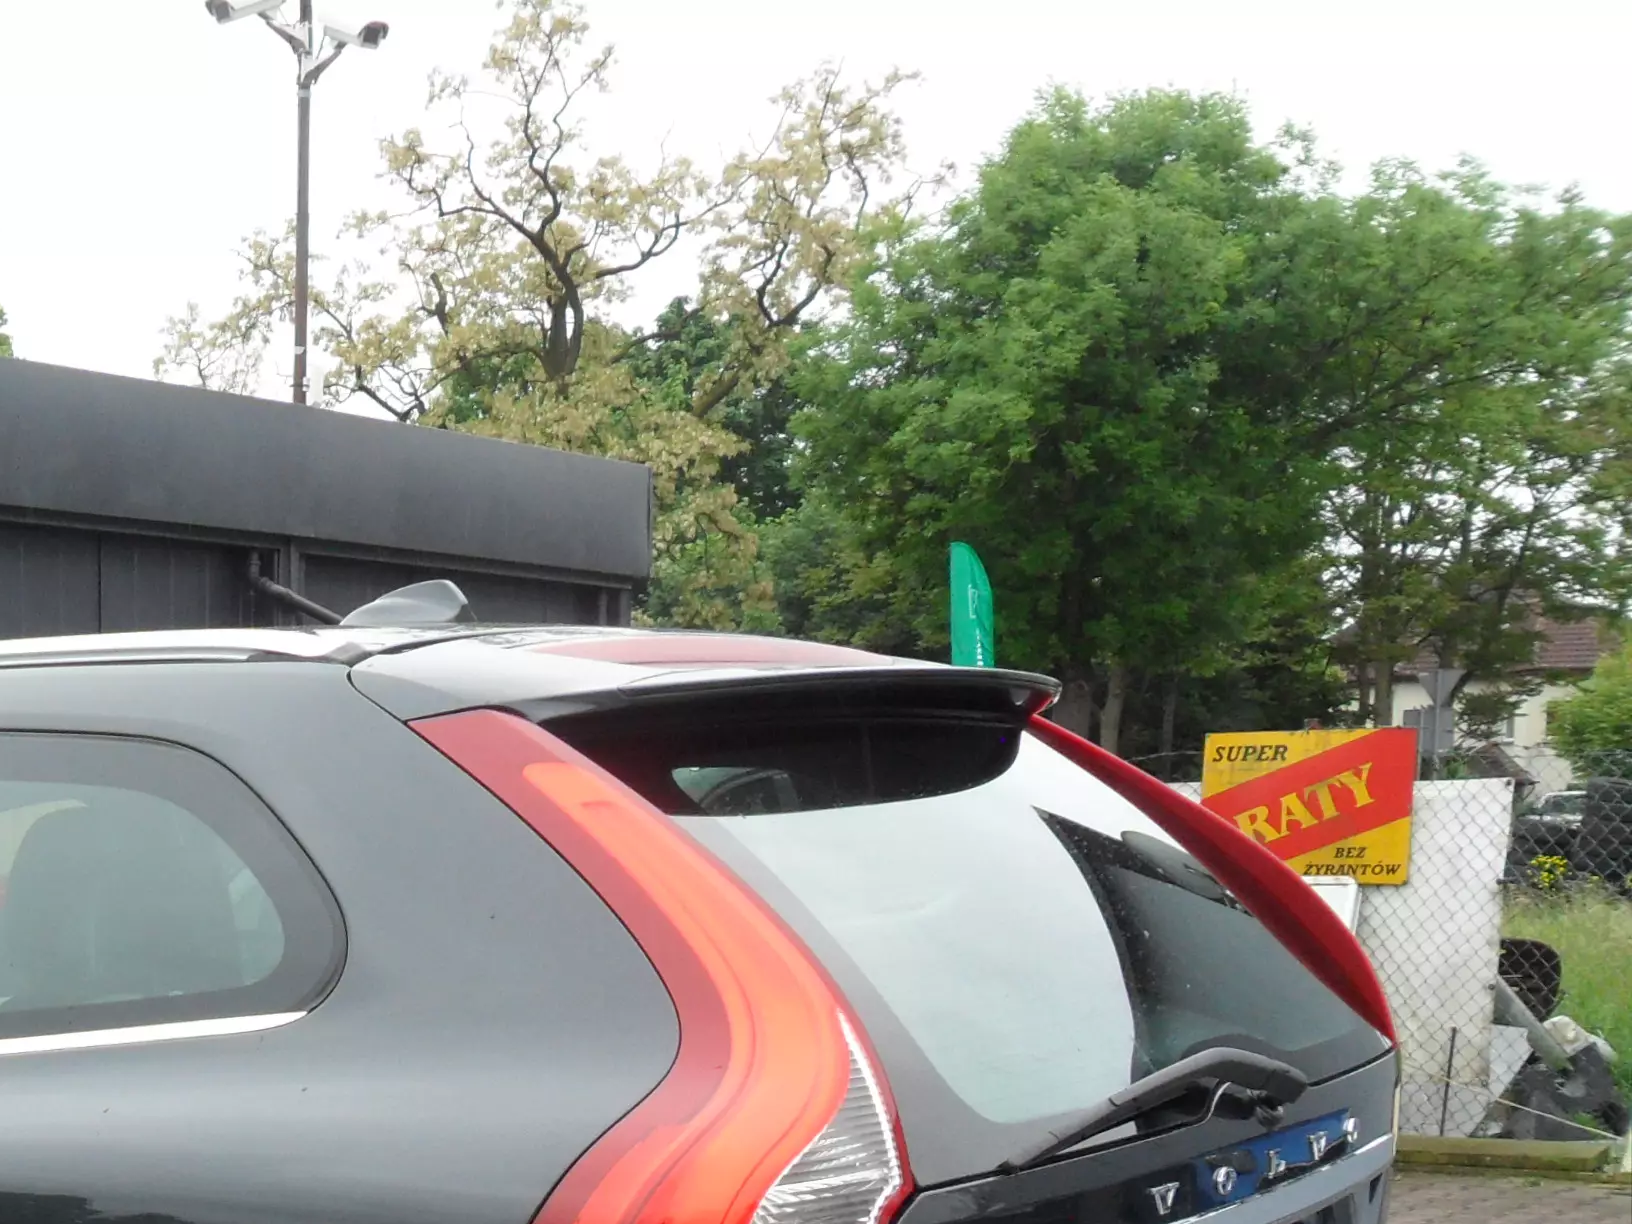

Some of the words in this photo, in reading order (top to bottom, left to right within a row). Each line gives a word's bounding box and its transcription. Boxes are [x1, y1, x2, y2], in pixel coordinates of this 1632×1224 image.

[1212, 744, 1288, 762] SUPER
[1233, 762, 1376, 844] RATY
[1334, 847, 1366, 859] BEZ
[1303, 860, 1402, 876] ŻYRANTÓW
[1146, 1117, 1361, 1216] VOLVO
